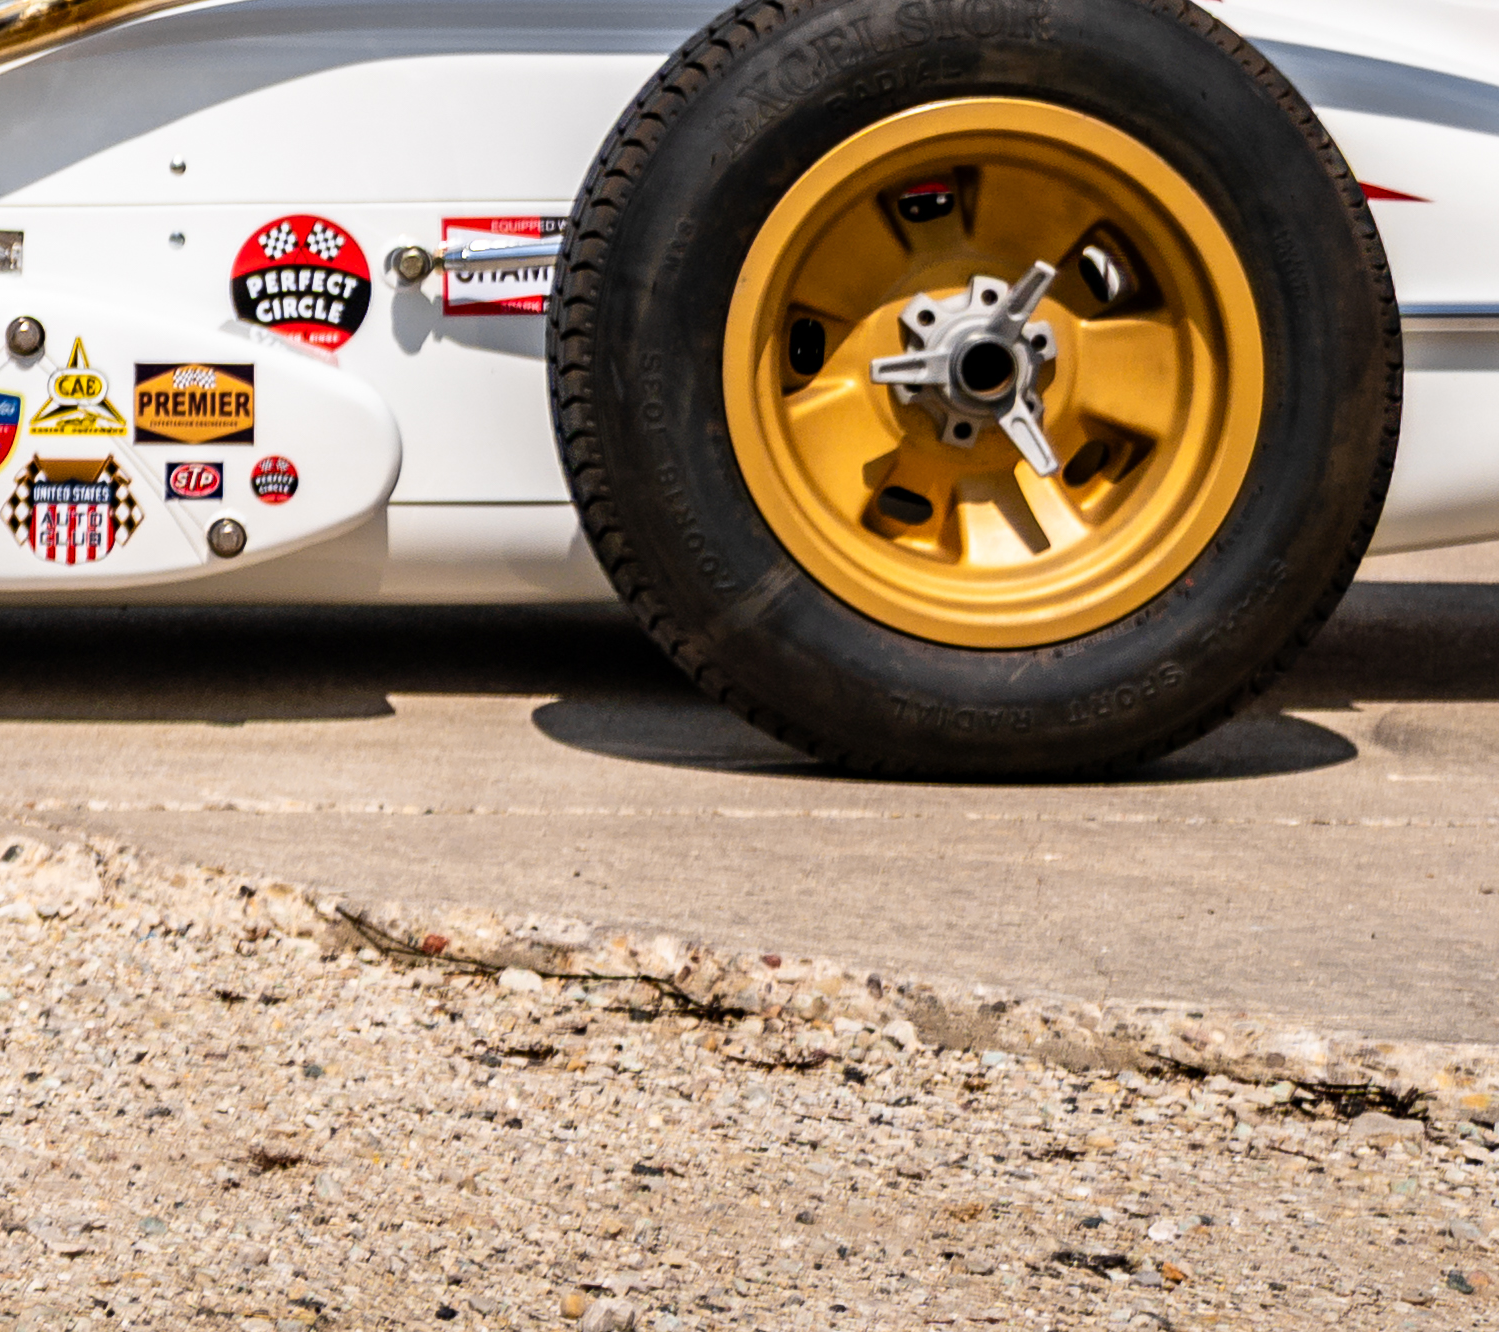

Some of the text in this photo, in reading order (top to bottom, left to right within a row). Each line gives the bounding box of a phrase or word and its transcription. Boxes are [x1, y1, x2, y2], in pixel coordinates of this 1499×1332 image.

[821, 53, 964, 122] RADIAL
[491, 219, 555, 233] EQUIPPED
[246, 268, 358, 300] PERFECT
[255, 296, 345, 325] CIRCLE
[58, 381, 97, 397] CAE
[138, 390, 250, 418] PREMIER
[173, 467, 215, 489] STP
[33, 485, 110, 504] UNITED STATES
[40, 510, 103, 528] AUTO
[39, 530, 102, 548] CLUB
[881, 691, 1034, 735] RADIAL
